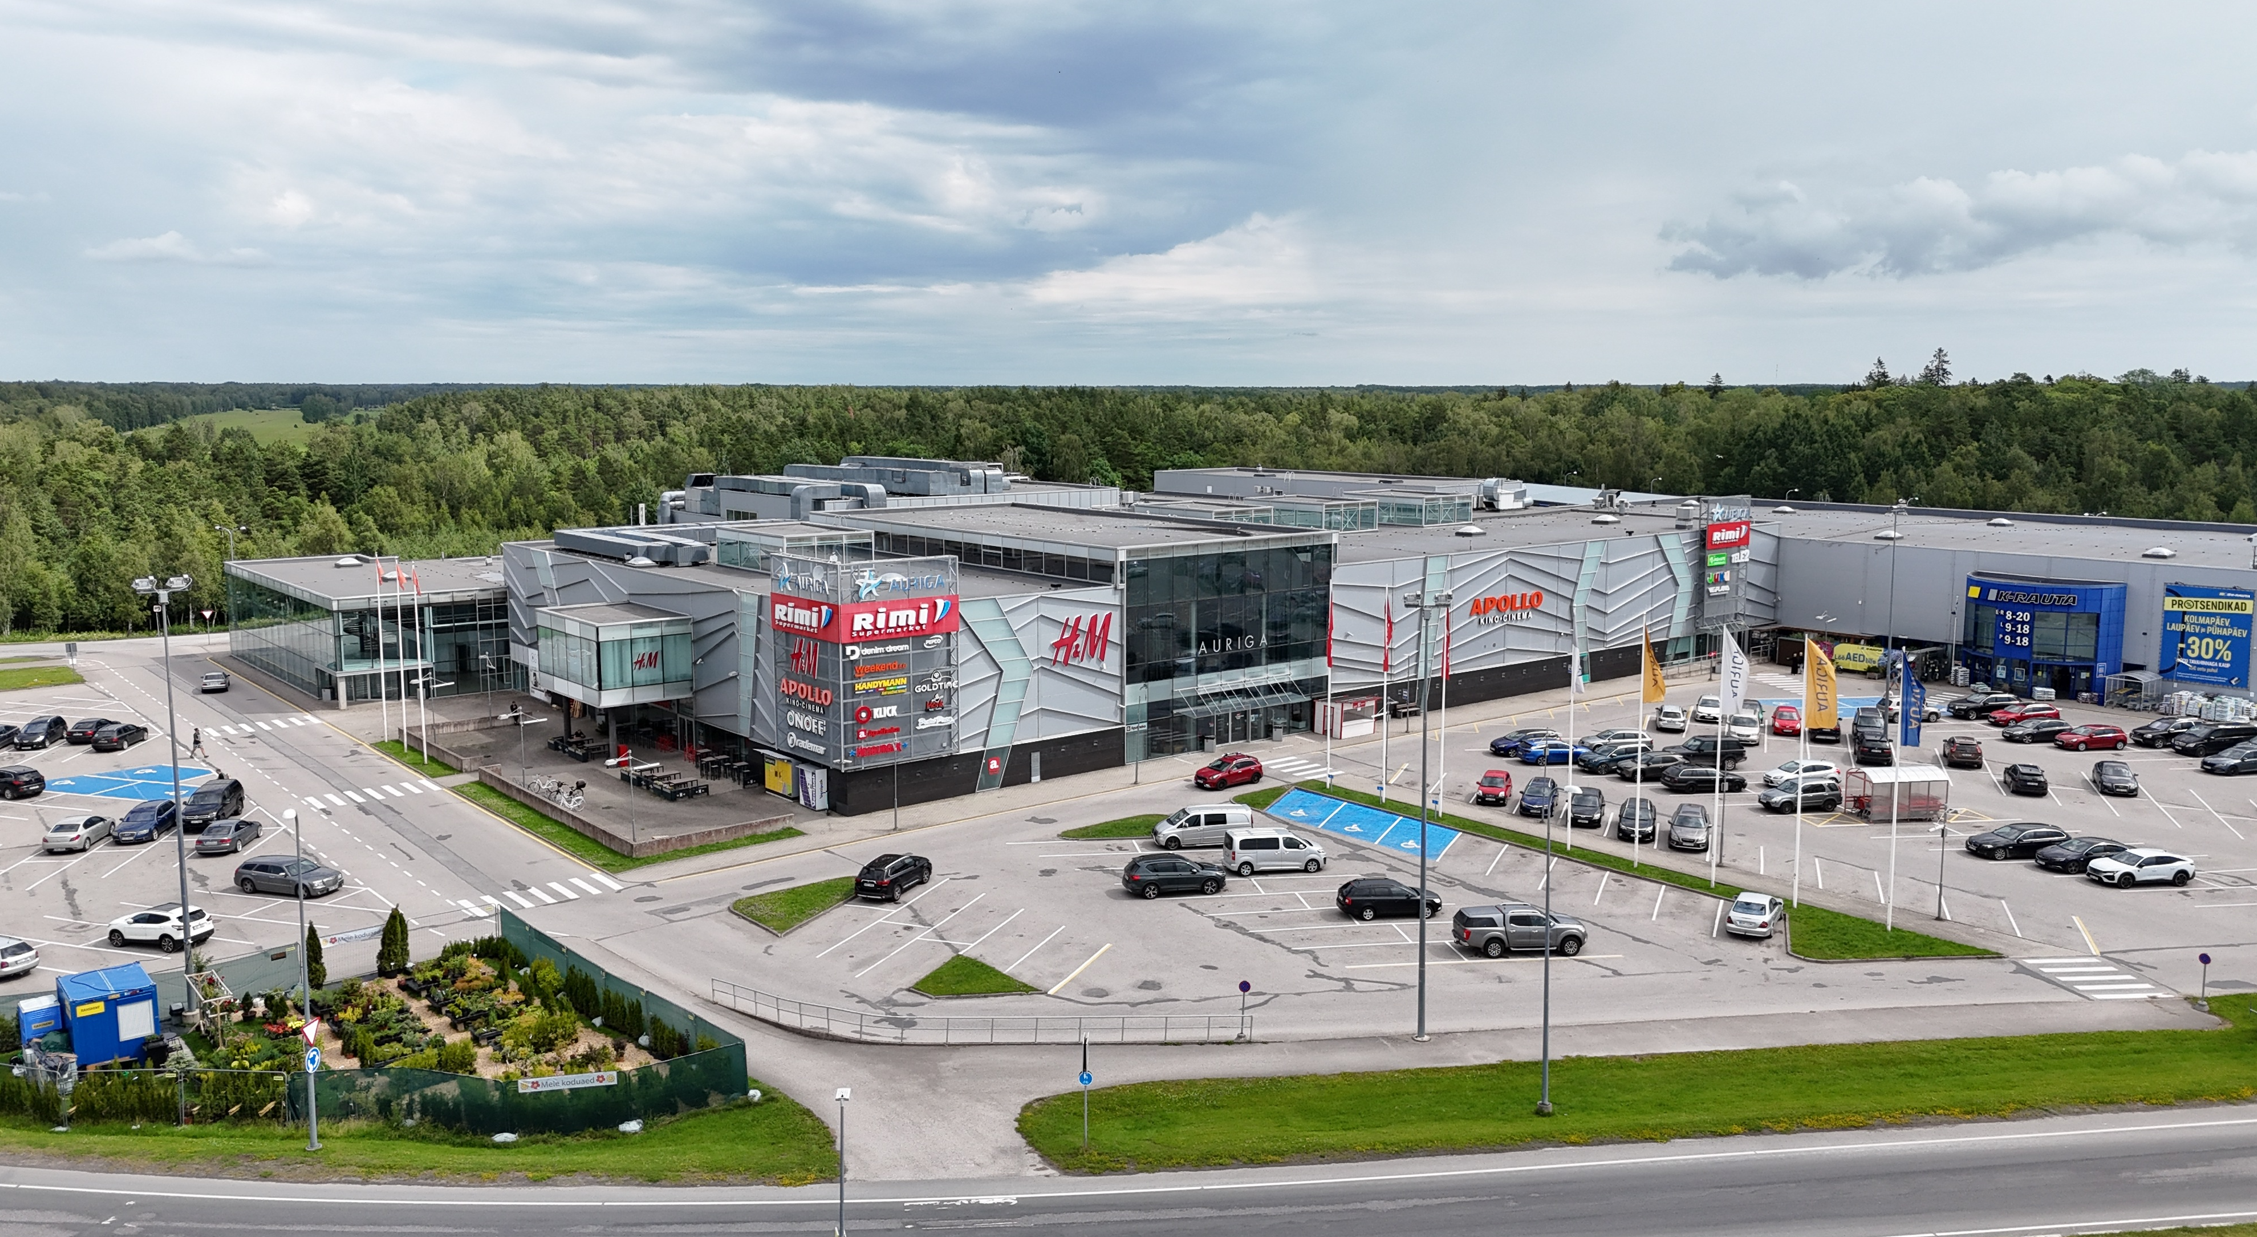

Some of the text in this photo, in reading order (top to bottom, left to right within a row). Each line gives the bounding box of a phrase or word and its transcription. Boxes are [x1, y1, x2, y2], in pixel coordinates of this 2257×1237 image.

[1712, 527, 1741, 541] Rimi
[1731, 549, 1750, 563] TELE2
[889, 574, 945, 593] AURIGA
[1469, 591, 1543, 616] APOLLO
[1998, 590, 2078, 606] K-RAUTA
[774, 602, 819, 628] Rimi
[852, 603, 929, 631] Rimi
[2005, 610, 2030, 622] 8-20
[775, 619, 818, 634] Supermarket
[851, 624, 927, 637] Supermarket
[2005, 622, 2030, 634] 9-18
[2166, 622, 2200, 633] LAUPÄEV
[2206, 625, 2248, 638] PÜHAPÄEV
[1051, 611, 1112, 666] H&M
[1199, 634, 1267, 654] AURIGA
[2004, 634, 2029, 646] 9-18
[861, 646, 884, 656] denim
[885, 644, 909, 654] dream
[2178, 635, 2232, 662] -30%
[634, 651, 659, 670] H&M
[790, 637, 820, 679] H&M
[1845, 652, 1866, 663] AED
[780, 678, 833, 706] APOLLO
[854, 677, 907, 691] HANDYMANN
[873, 705, 897, 719] KLICK
[787, 710, 826, 736] ONOFF
[541, 1076, 595, 1089] Meie koduaed
